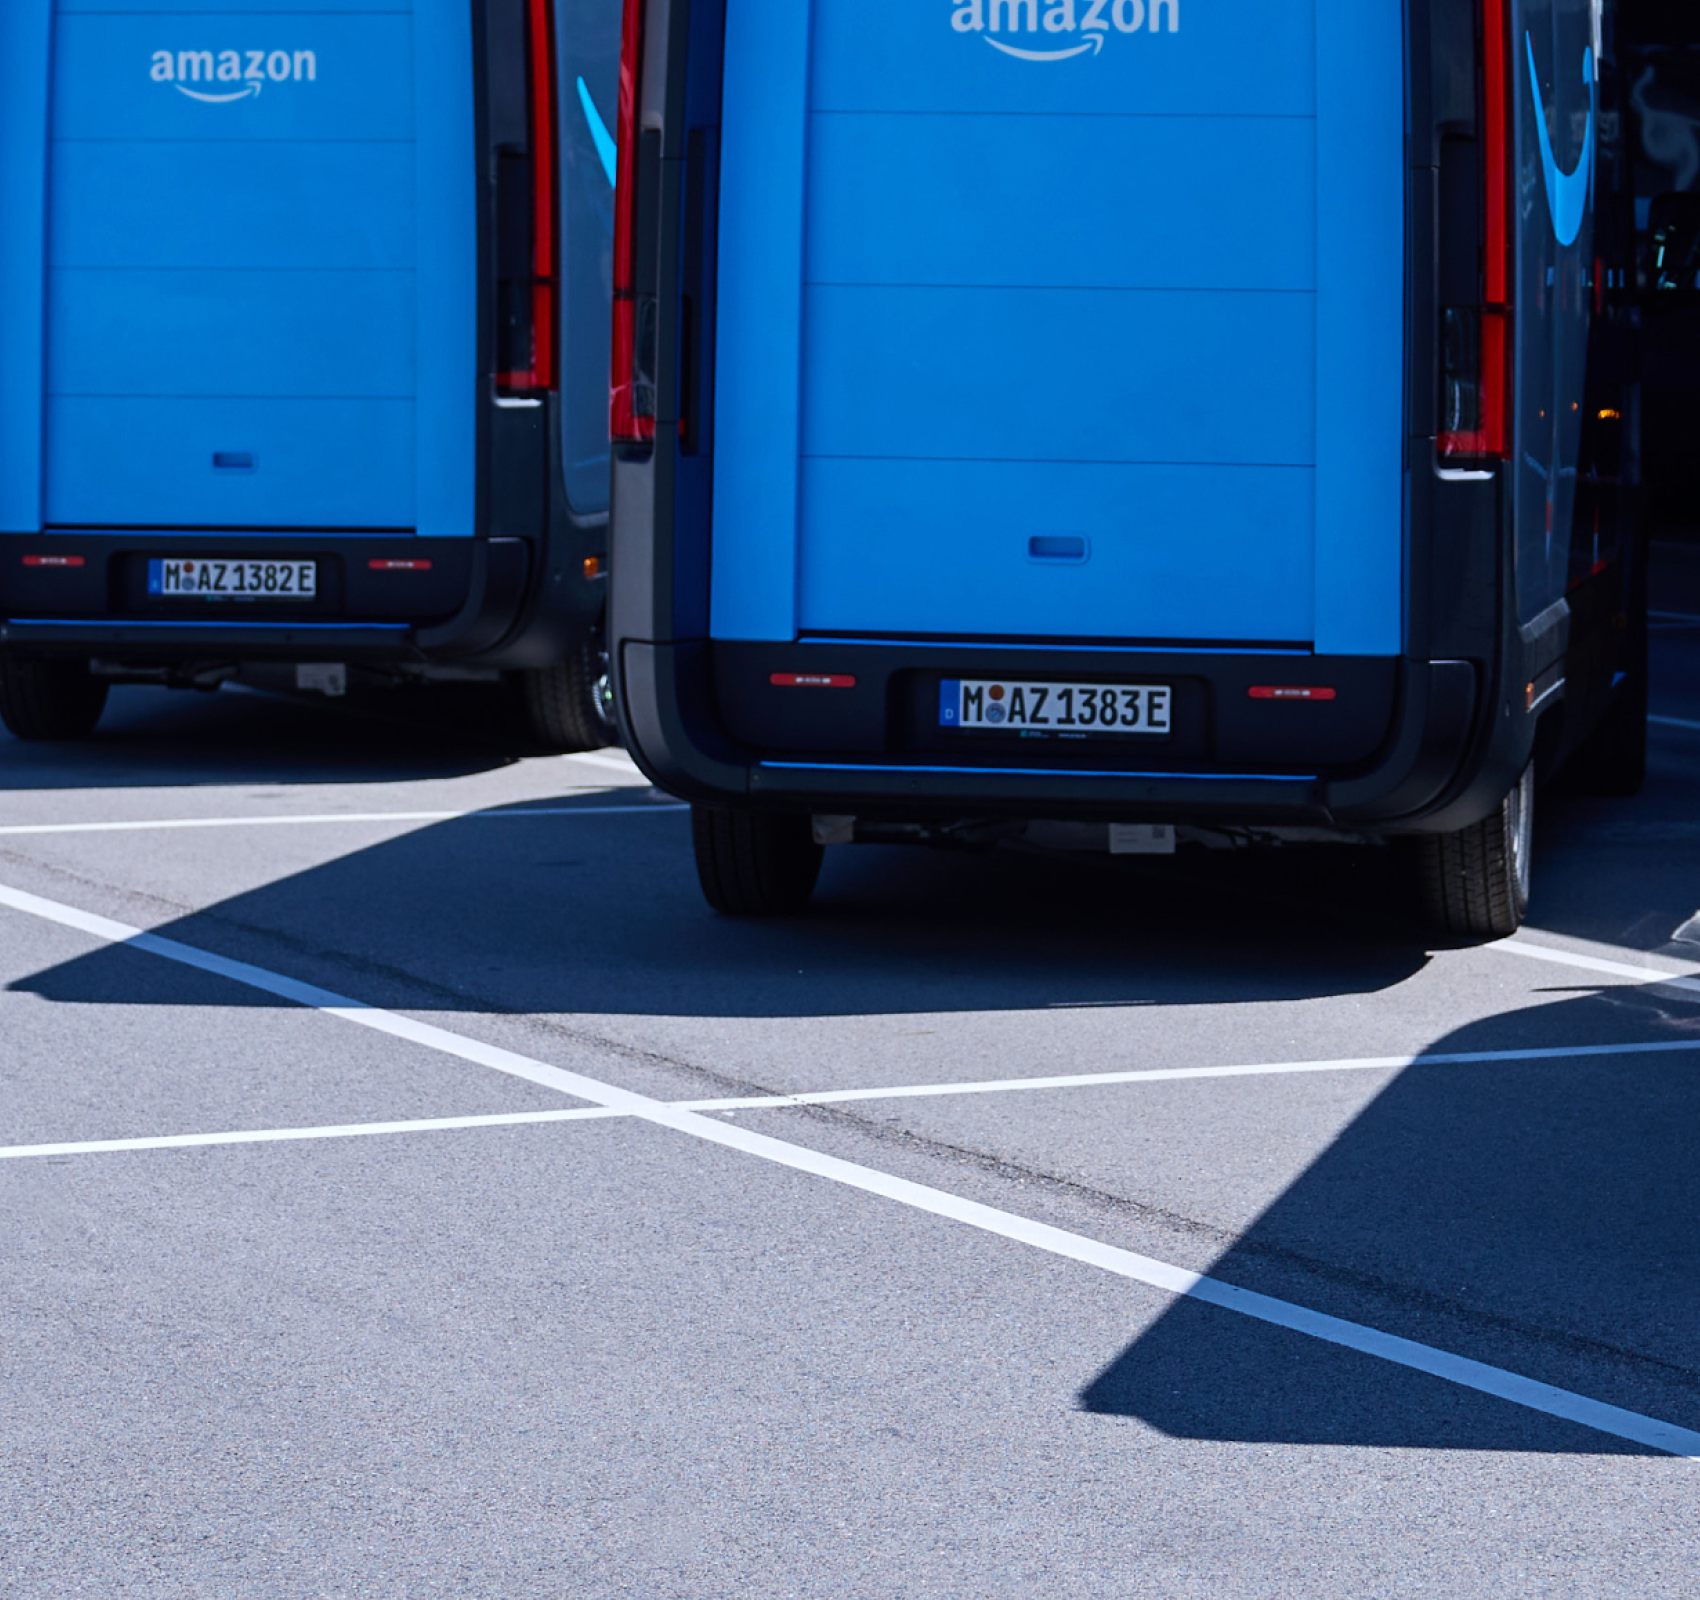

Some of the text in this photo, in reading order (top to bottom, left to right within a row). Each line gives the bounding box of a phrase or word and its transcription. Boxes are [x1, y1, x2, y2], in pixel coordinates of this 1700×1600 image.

[150, 50, 316, 82] amazon
[165, 563, 180, 591] M
[963, 685, 983, 722] M
[1008, 687, 1049, 724] AZ
